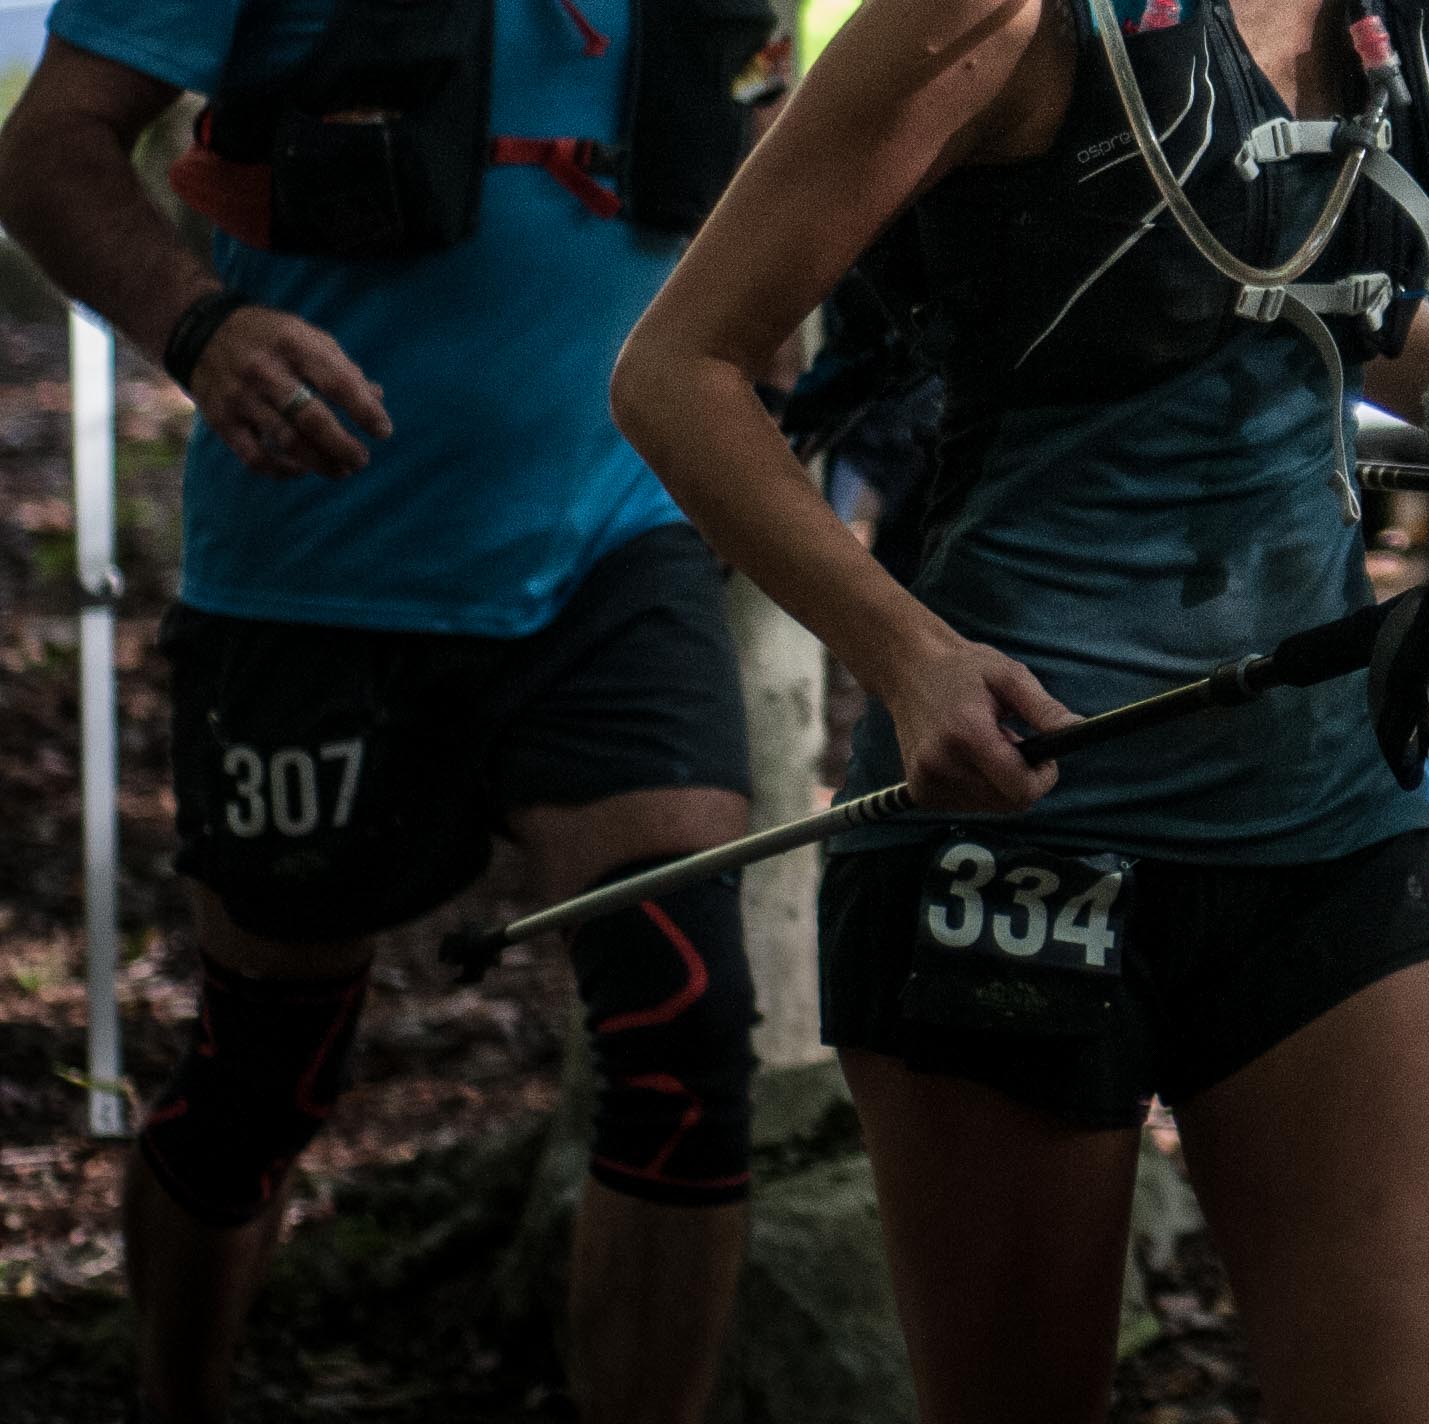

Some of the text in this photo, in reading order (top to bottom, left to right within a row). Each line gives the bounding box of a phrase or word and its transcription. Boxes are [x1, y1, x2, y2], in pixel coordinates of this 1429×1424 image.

[1076, 131, 1133, 164] ospre
[222, 738, 366, 839] 307
[927, 843, 1123, 967] 334
